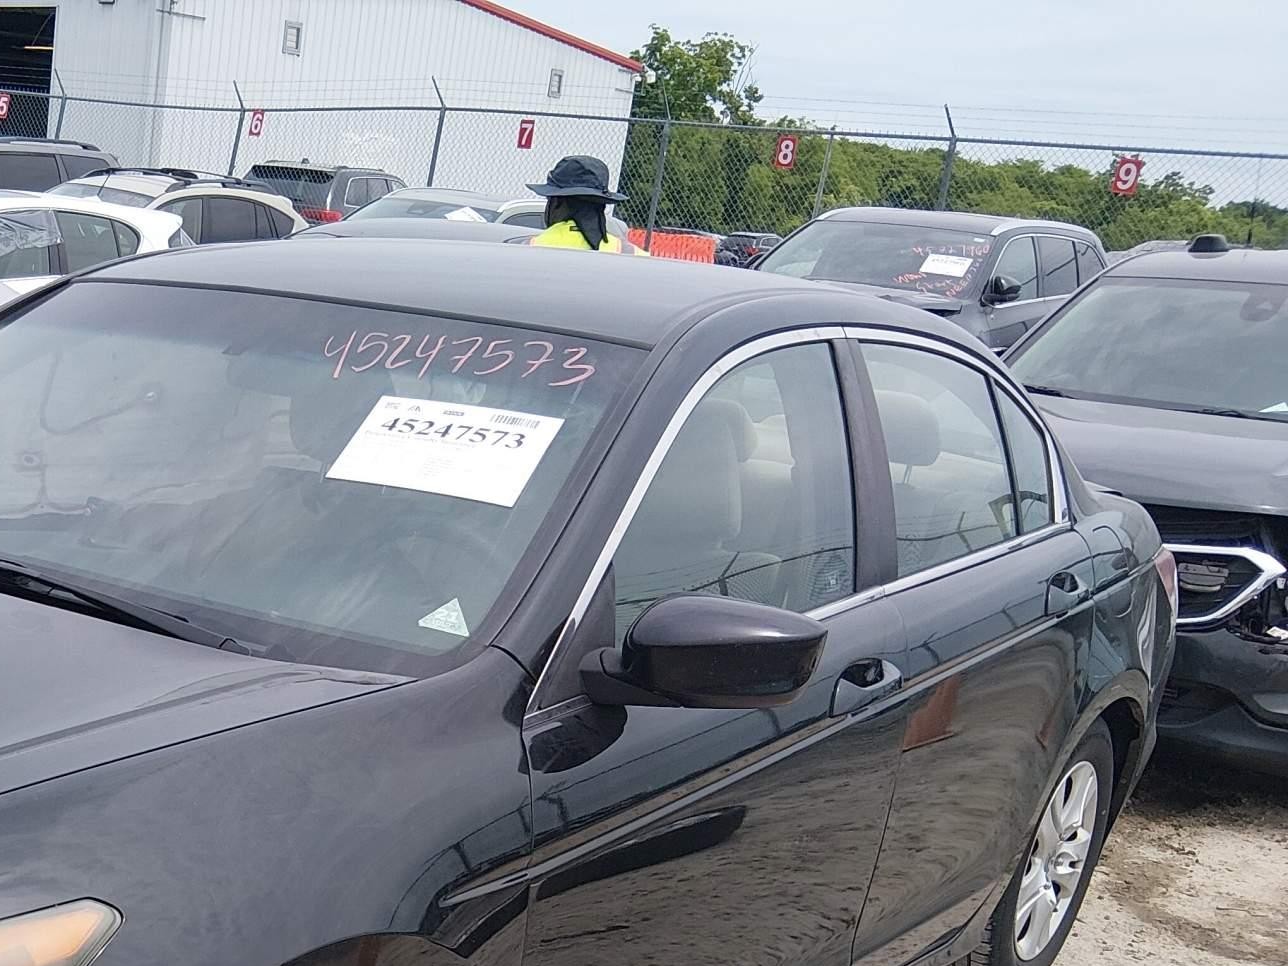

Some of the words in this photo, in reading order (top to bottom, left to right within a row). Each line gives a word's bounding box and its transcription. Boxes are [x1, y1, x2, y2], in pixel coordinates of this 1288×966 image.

[251, 113, 263, 134] 6
[520, 123, 533, 146] 7
[777, 139, 794, 165] 8
[1116, 162, 1138, 190] 9
[324, 330, 596, 387] 45247573
[381, 417, 527, 449] 45247573
